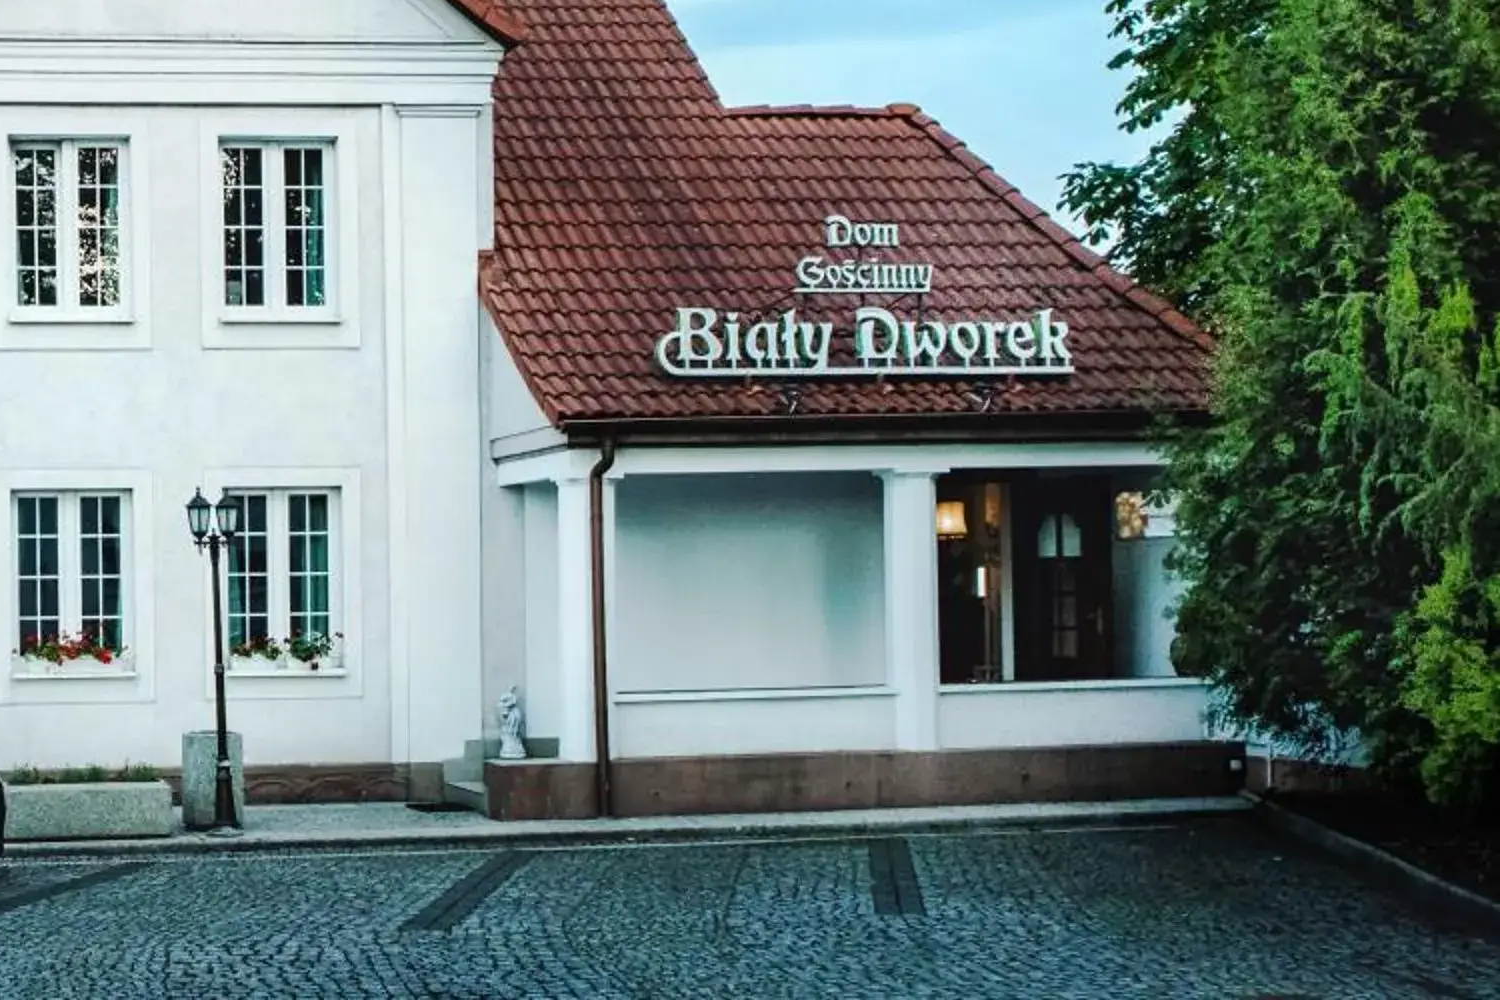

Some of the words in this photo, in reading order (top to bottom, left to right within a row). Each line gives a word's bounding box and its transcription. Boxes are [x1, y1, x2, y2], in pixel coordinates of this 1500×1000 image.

[825, 215, 899, 247] Dom
[796, 256, 933, 292] Gościnny
[656, 307, 833, 375] Biały
[856, 307, 1072, 362] Dworek
